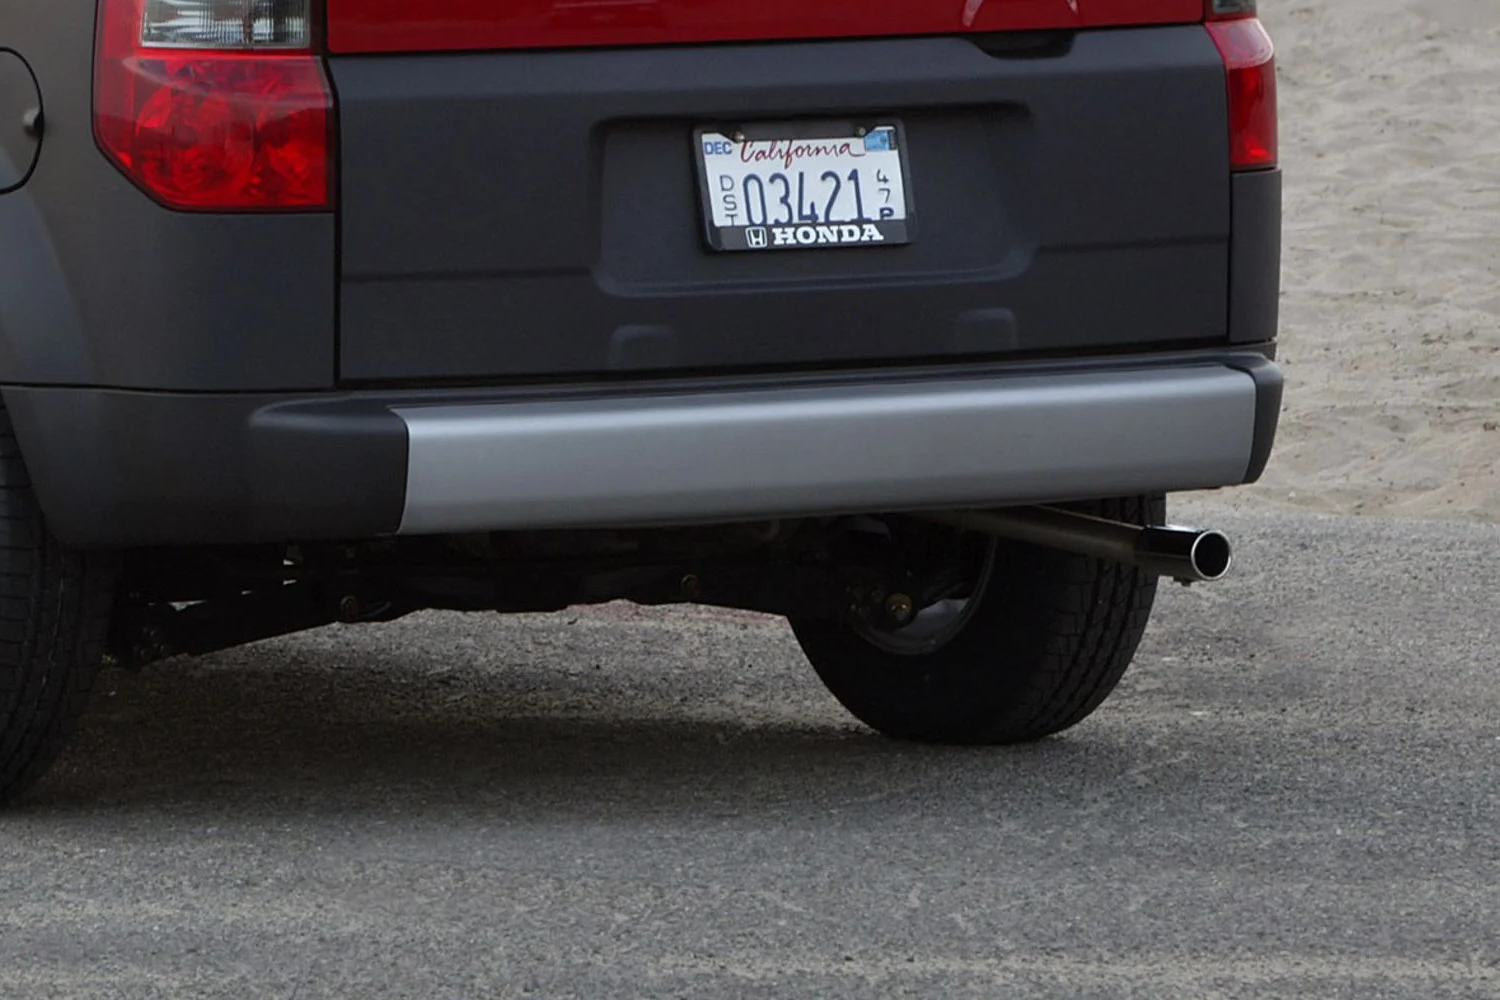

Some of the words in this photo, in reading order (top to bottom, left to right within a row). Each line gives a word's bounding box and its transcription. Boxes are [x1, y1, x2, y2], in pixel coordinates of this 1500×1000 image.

[704, 141, 732, 155] DEC
[740, 139, 866, 169] California
[743, 168, 872, 225] 03421
[772, 224, 884, 245] HONDA
